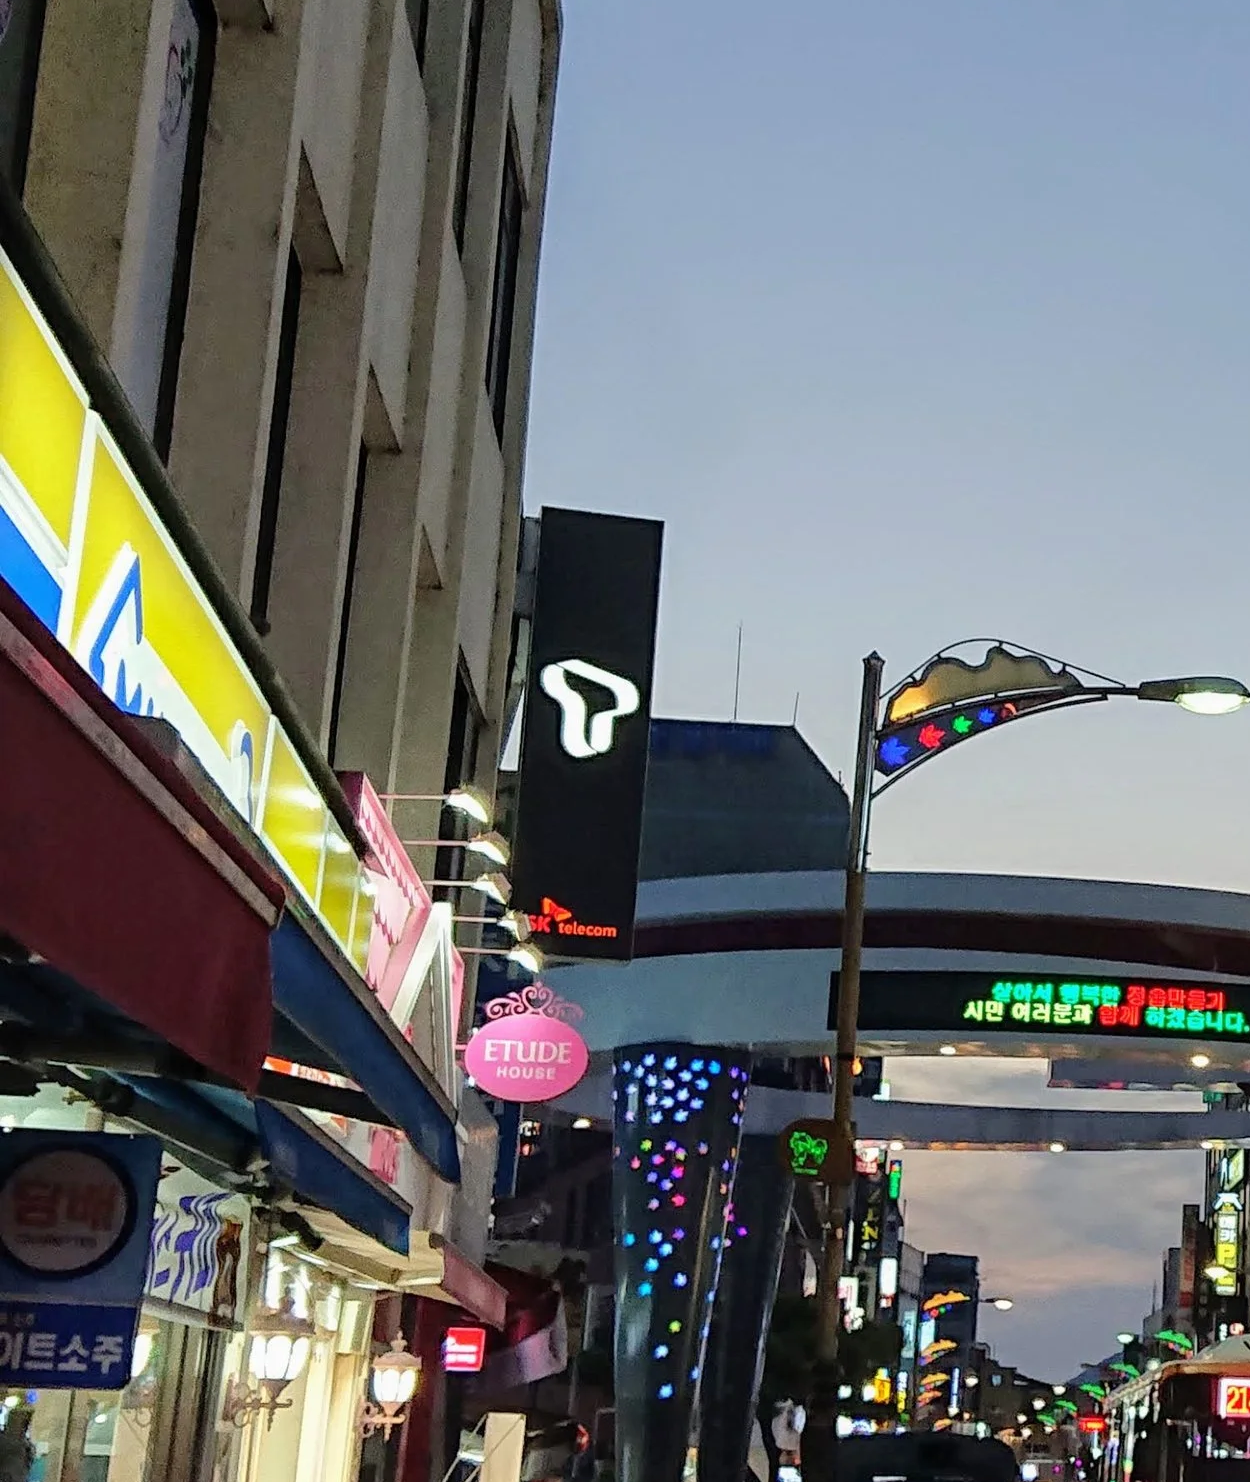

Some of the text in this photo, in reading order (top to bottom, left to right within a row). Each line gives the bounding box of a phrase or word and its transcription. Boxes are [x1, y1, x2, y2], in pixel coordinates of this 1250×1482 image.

[558, 921, 618, 939] telecom
[963, 1000, 1004, 1022] 시민
[1011, 1001, 1093, 1025] 여러분과
[1144, 1006, 1250, 1033] 하겠습니다.
[483, 1038, 572, 1064] ETUDE
[495, 1066, 557, 1080] HOUSE
